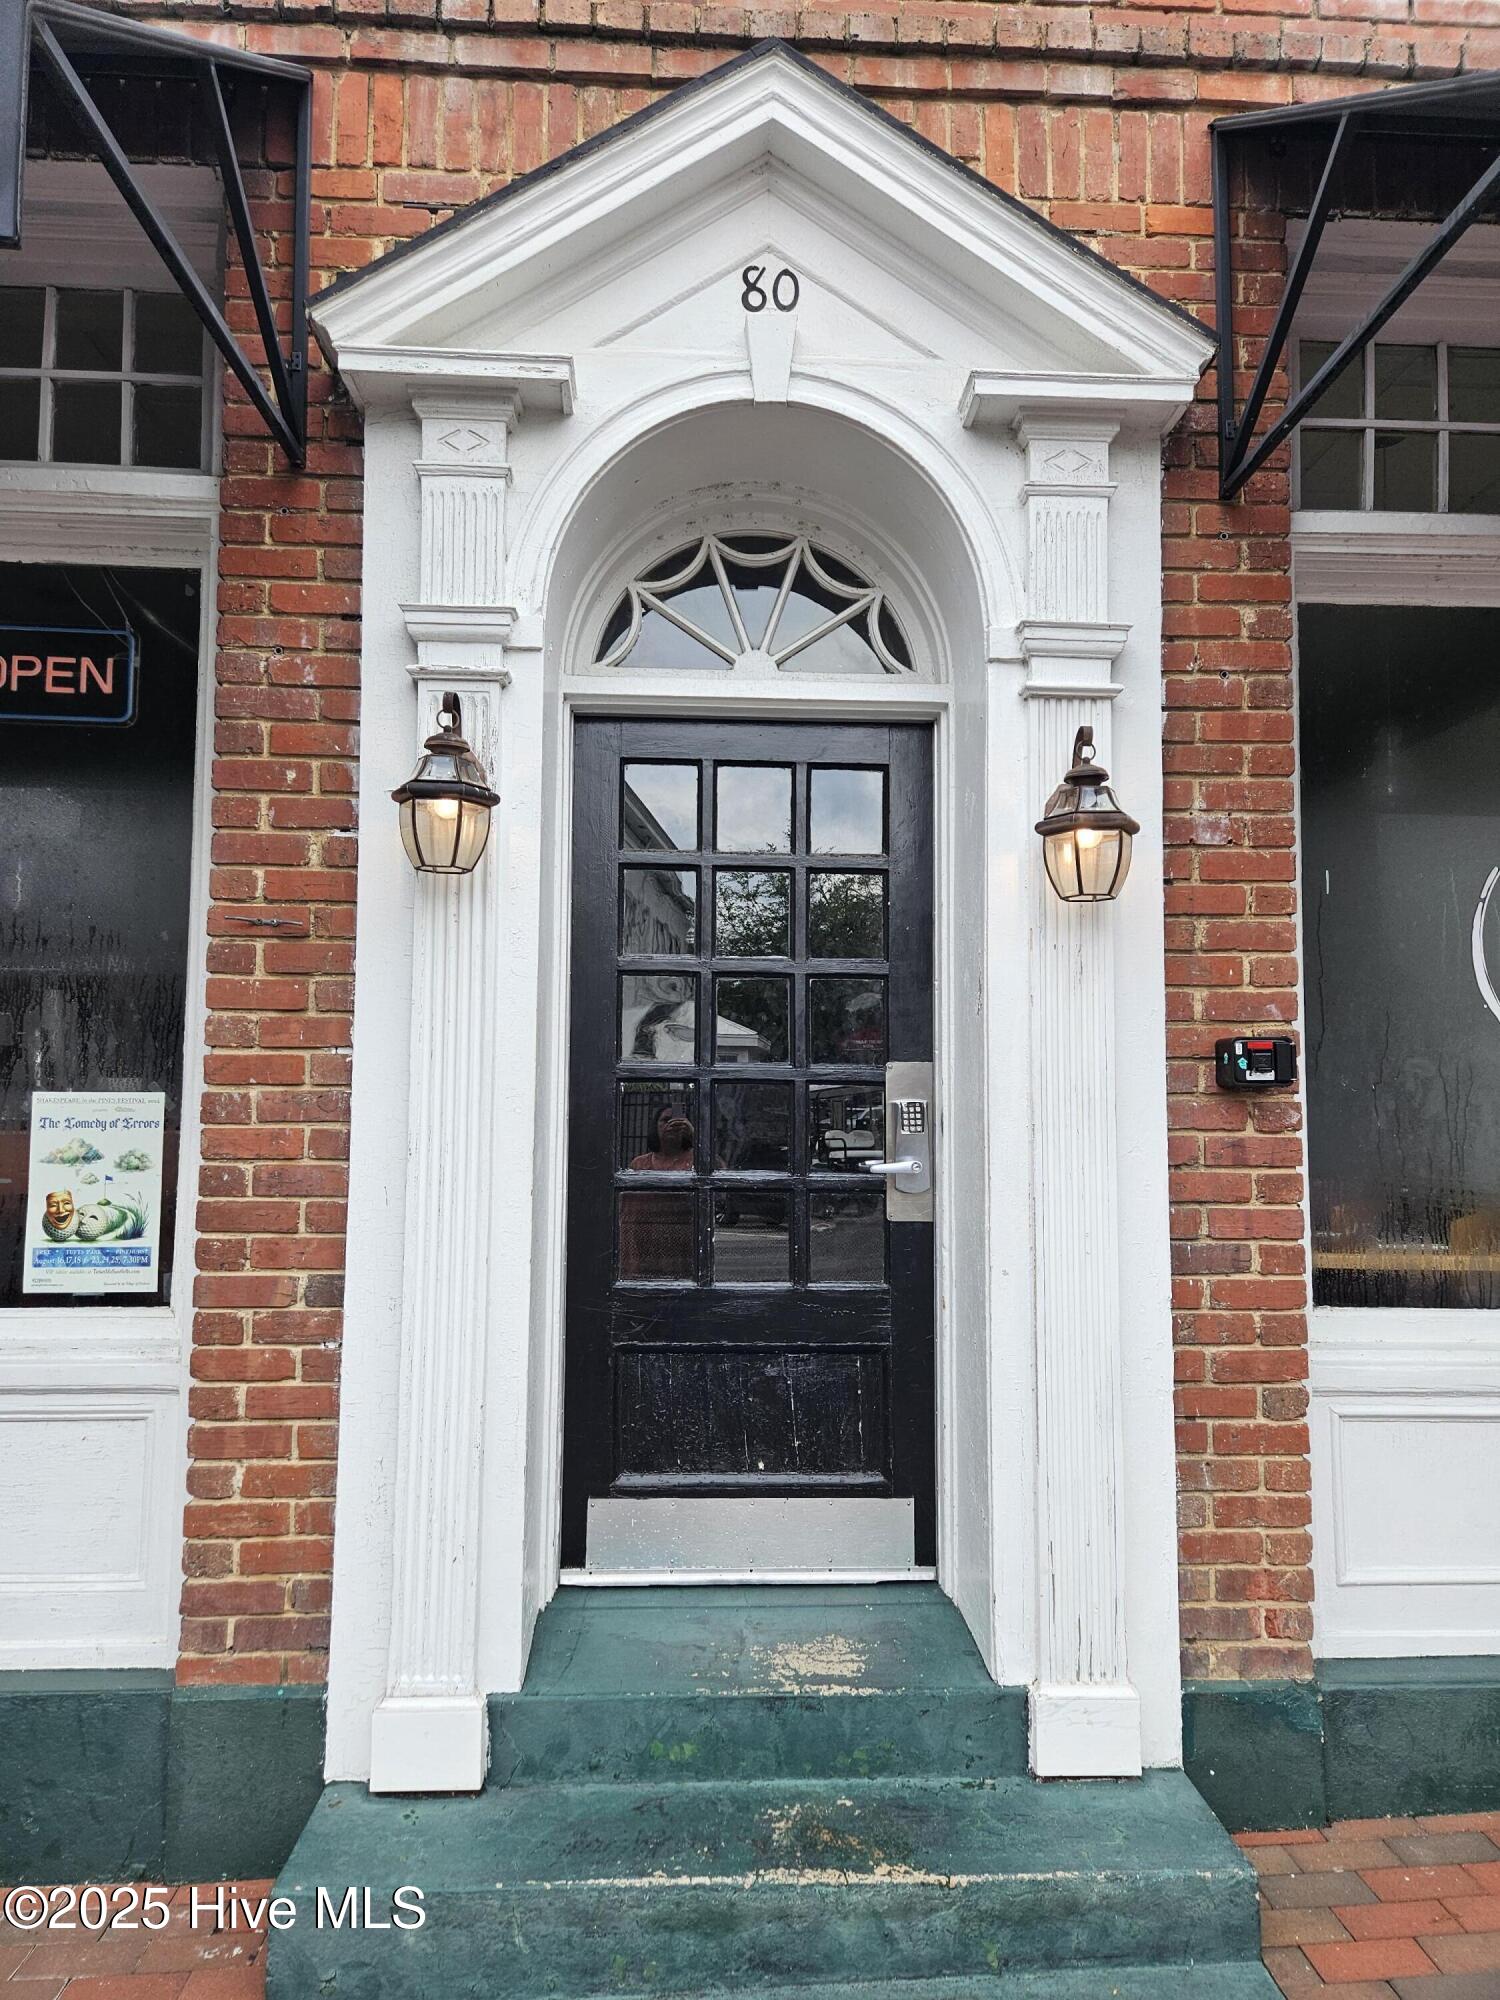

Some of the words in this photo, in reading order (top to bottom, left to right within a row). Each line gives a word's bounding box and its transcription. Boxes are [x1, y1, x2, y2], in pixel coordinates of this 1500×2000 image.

[741, 265, 799, 312] 80
[0, 655, 114, 694] PEN
[39, 1117, 61, 1129] The
[64, 1117, 107, 1132] Comedy
[109, 1117, 121, 1129] of
[122, 1117, 160, 1129] Errors
